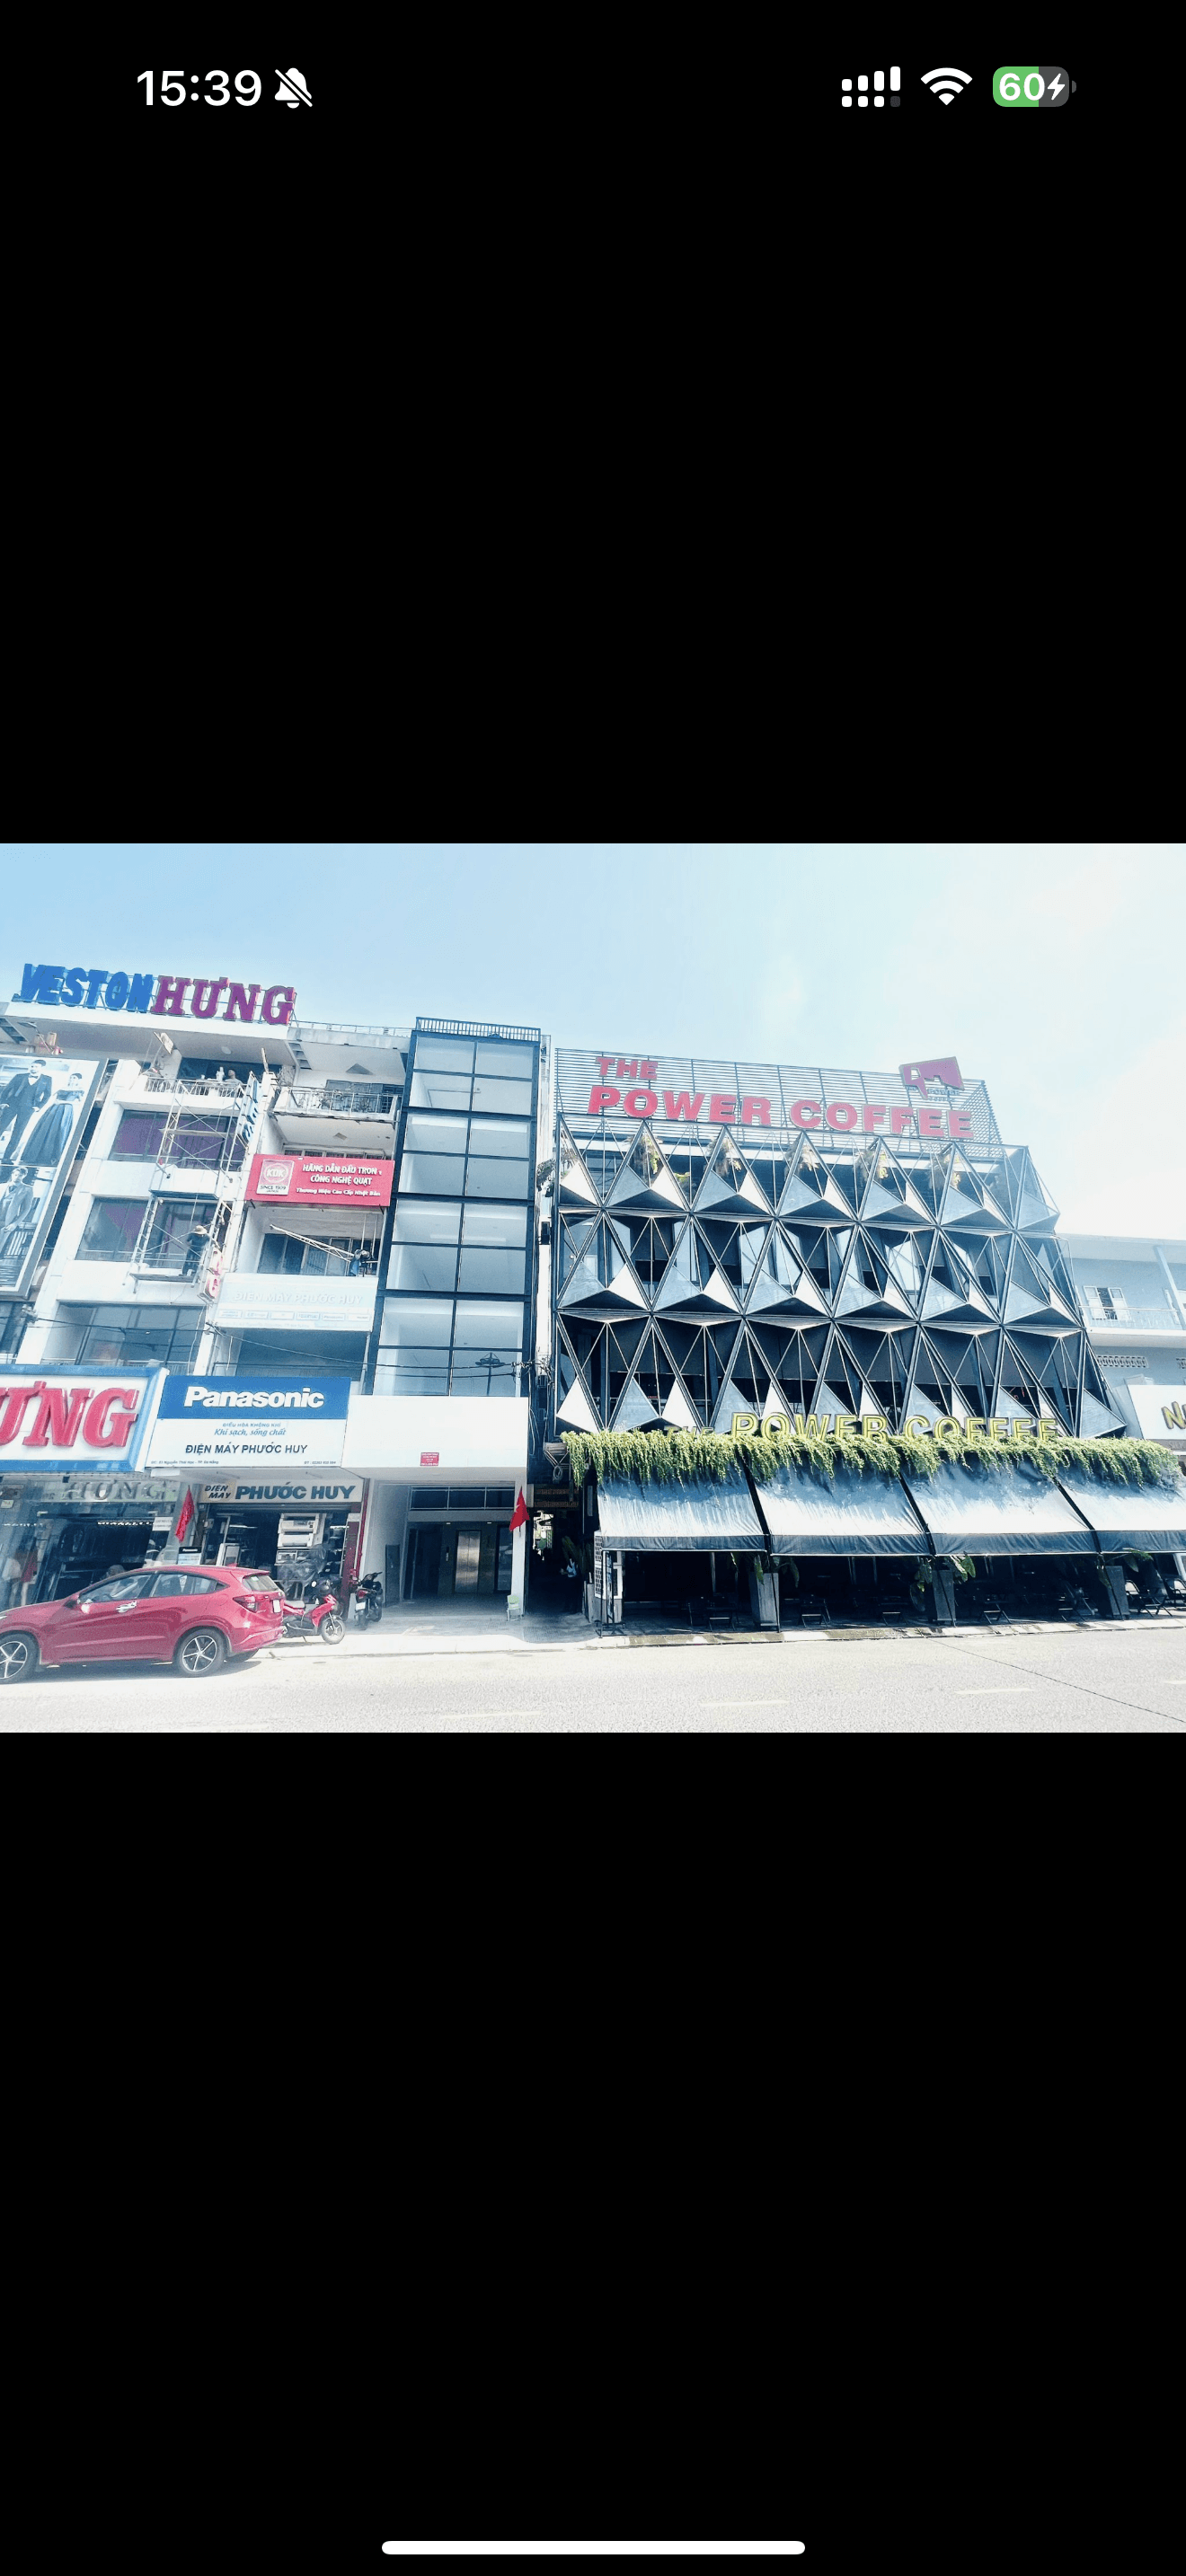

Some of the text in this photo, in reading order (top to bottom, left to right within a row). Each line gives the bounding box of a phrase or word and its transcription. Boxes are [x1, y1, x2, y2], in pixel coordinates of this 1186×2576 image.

[12, 963, 296, 1025] VESTON HƯNG
[596, 1057, 659, 1081] THE
[588, 1086, 975, 1139] POWER COFFEE
[310, 1174, 373, 1187] CÔNG NGHỆ QUẠT
[338, 1294, 363, 1304] HUY
[183, 1386, 324, 1408] Panasonic
[1161, 1401, 1186, 1429] N
[229, 1428, 248, 1437] sạch,
[250, 1427, 268, 1437] sống
[269, 1427, 287, 1435] chất
[185, 1442, 308, 1455] ĐIỆN MÁY PHƯỚC HUY
[235, 1482, 356, 1500] PHƯỚC HUY
